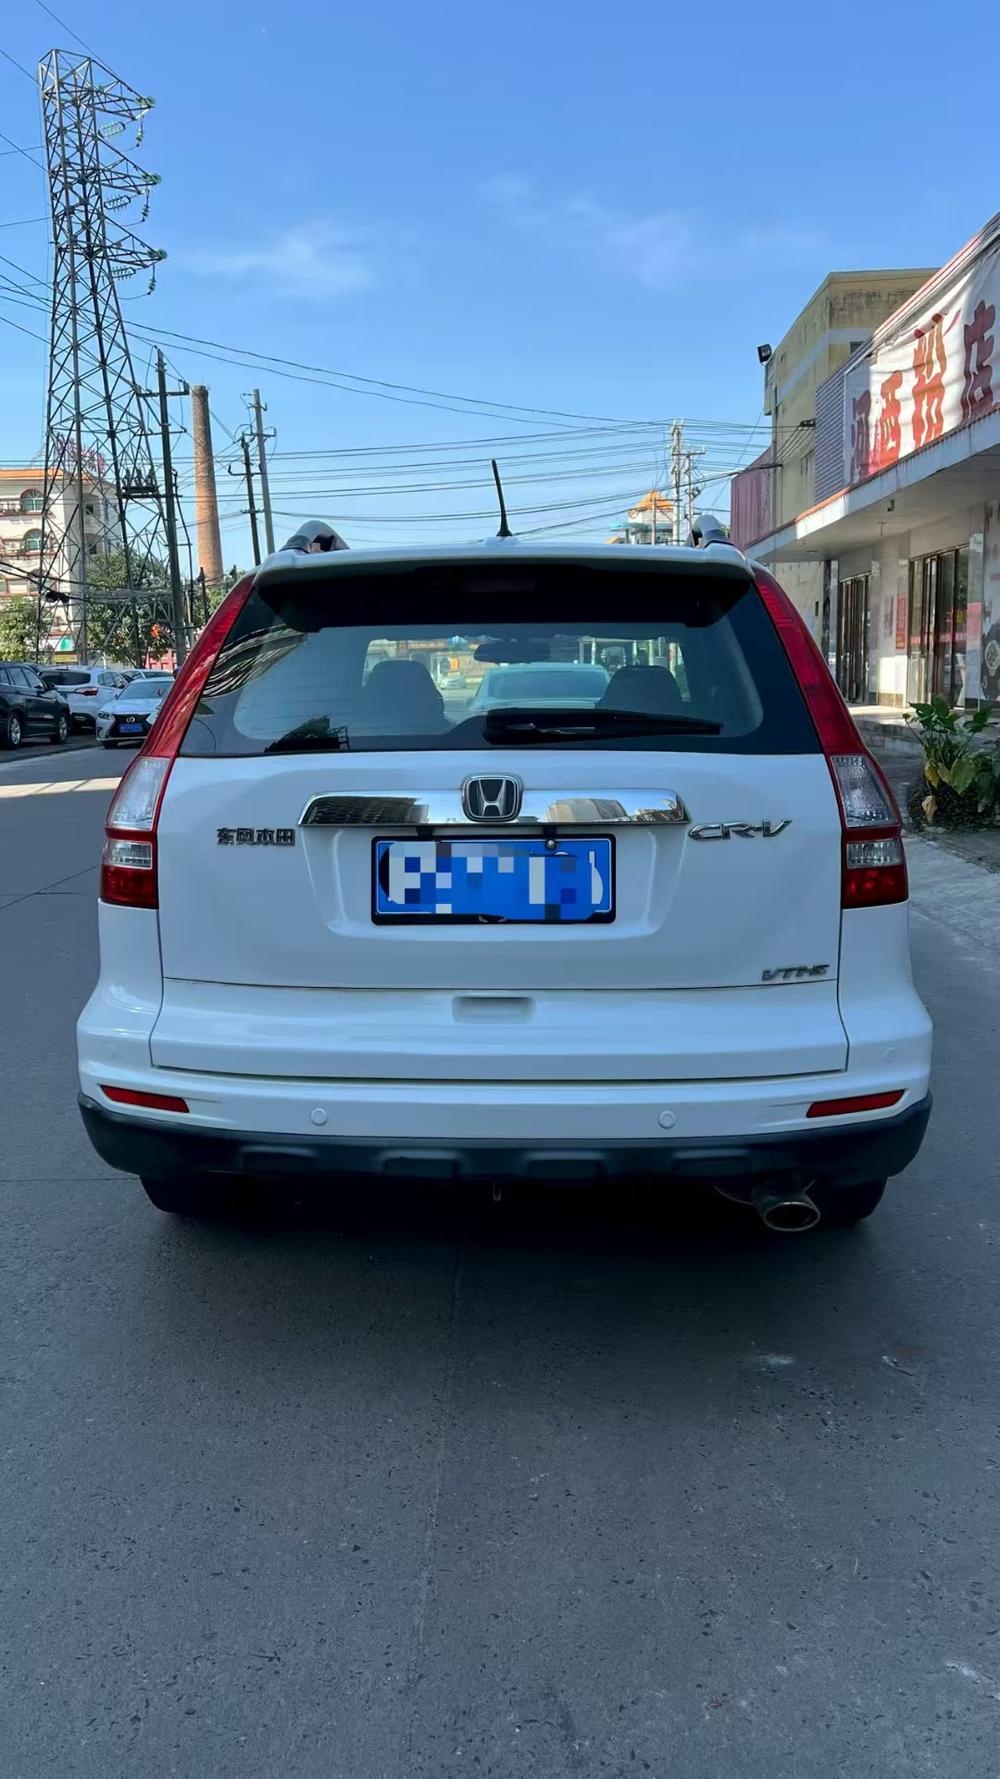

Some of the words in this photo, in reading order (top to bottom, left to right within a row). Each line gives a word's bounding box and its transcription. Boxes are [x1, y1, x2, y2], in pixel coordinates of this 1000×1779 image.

[217, 827, 296, 846] 东风本田
[688, 819, 793, 840] CR-V
